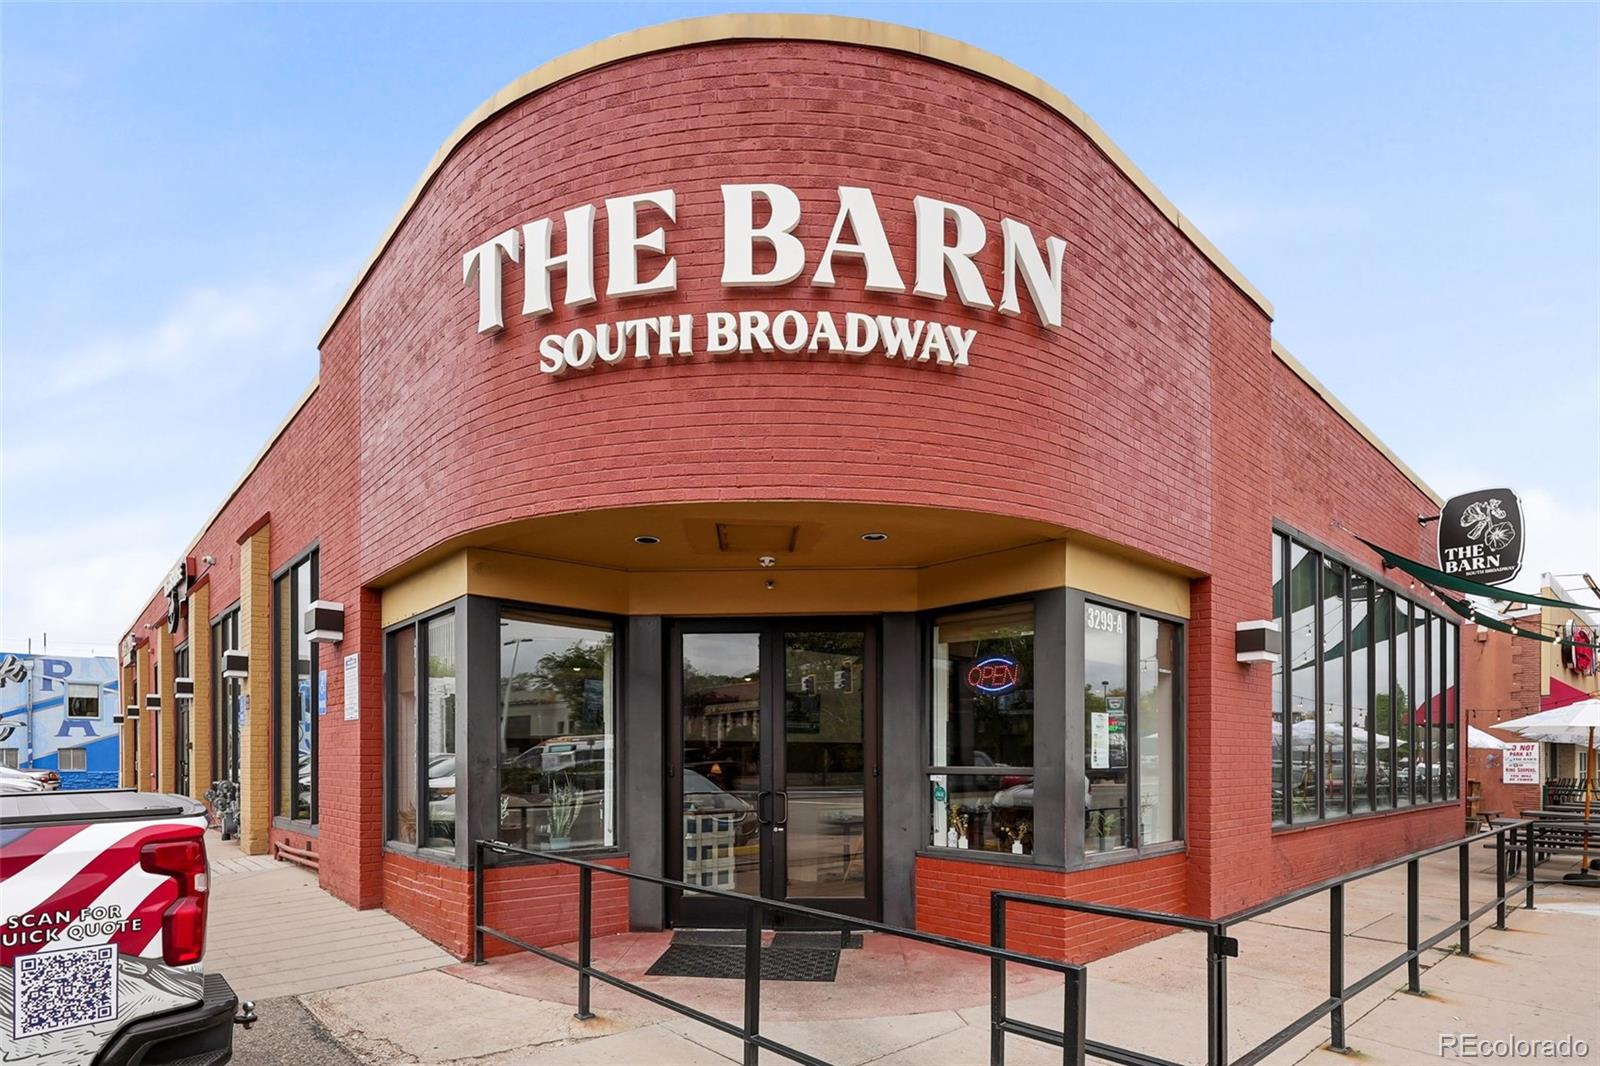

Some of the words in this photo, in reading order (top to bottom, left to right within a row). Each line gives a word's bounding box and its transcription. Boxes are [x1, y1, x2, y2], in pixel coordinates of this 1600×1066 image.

[462, 189, 678, 333] THE
[720, 183, 1067, 329] BARN
[539, 313, 694, 376] SOUTH
[706, 310, 978, 368] BROADWAY
[1445, 544, 1484, 560] THE
[1445, 555, 1500, 573] BARN
[1087, 607, 1123, 634] 3299-A
[968, 664, 1019, 686] OPEN
[7, 910, 71, 929] SCAN
[79, 905, 122, 921] FOR
[1, 928, 60, 946] UICK
[67, 918, 142, 941] QUOTE
